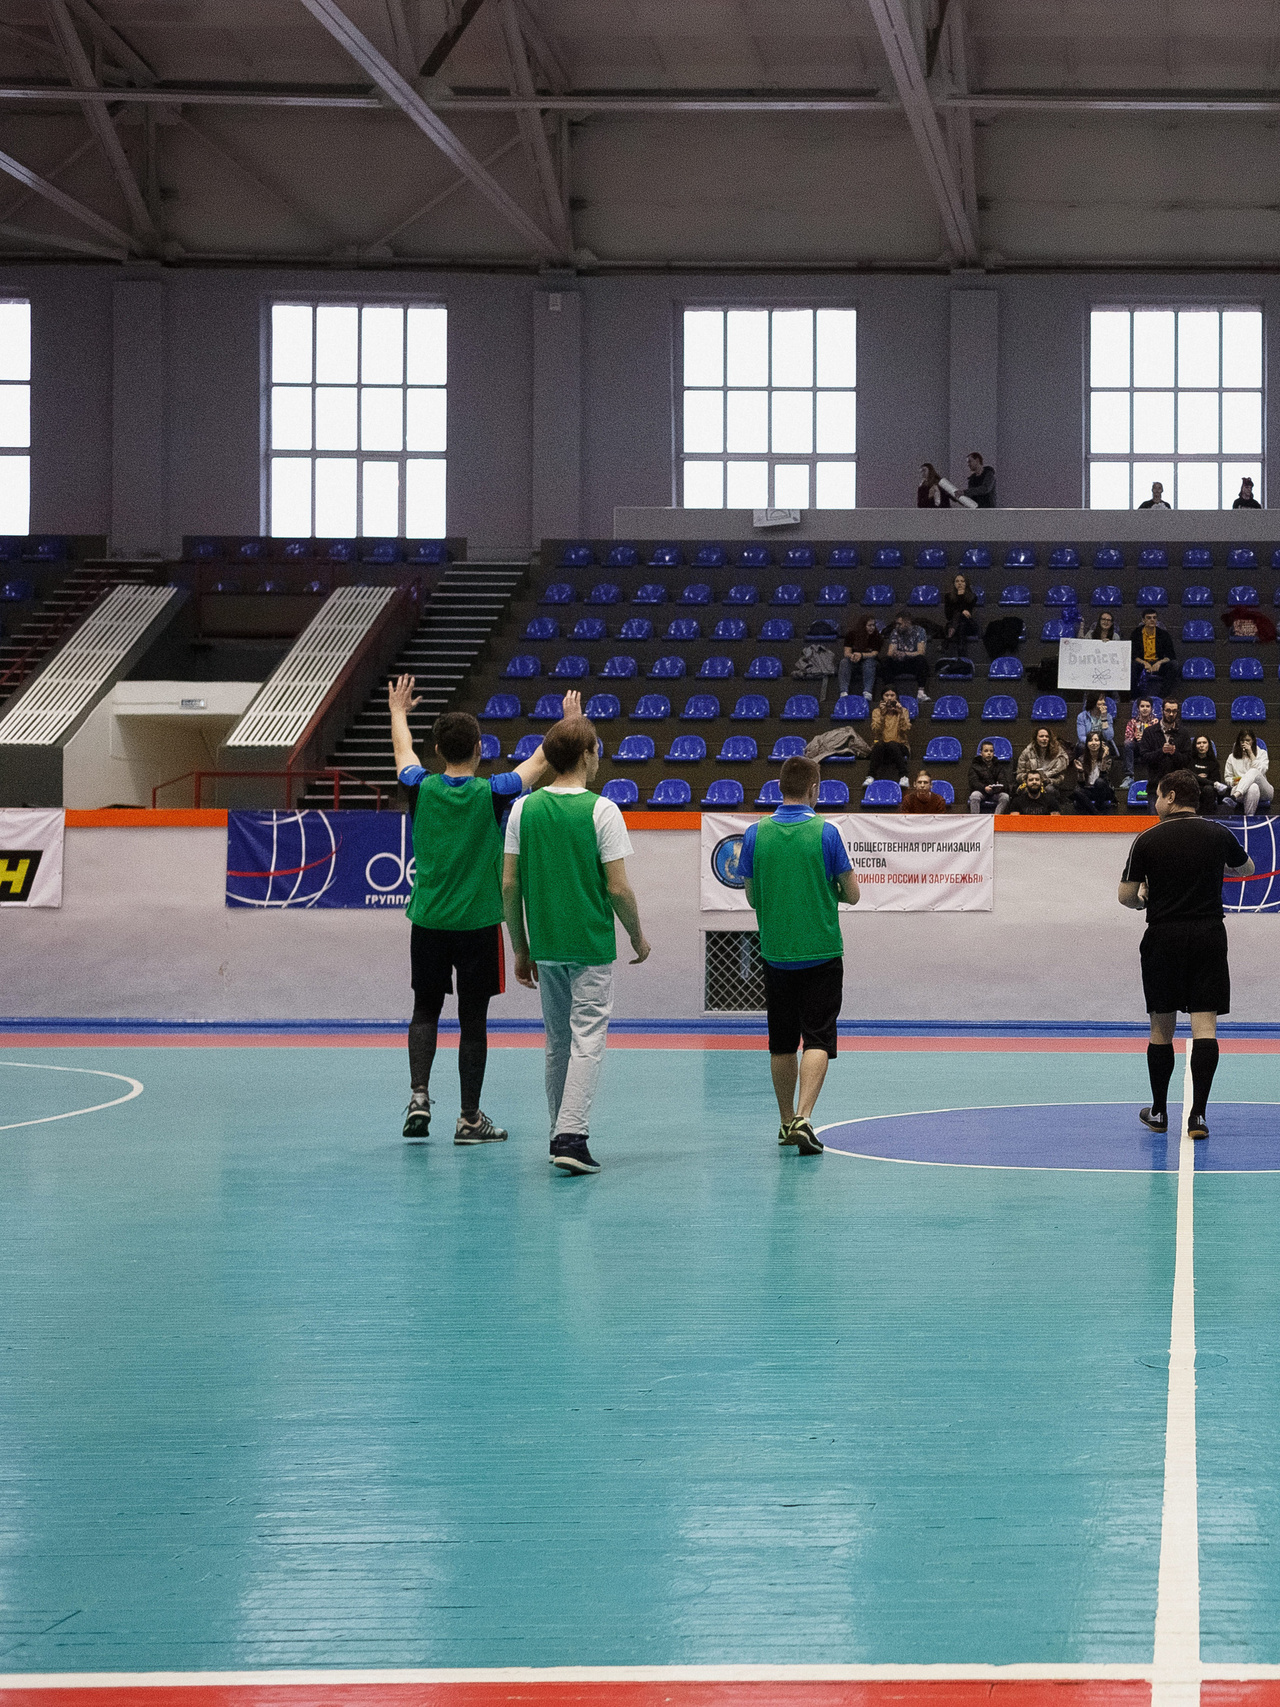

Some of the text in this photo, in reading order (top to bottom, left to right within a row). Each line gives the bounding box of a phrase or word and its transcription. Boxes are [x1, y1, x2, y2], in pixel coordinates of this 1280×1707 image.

[853, 841, 919, 853] ОБЩЕСТВЕННАЯ
[921, 841, 981, 853] ОРГАНИЗАЦИЯ
[887, 873, 919, 884] РОССИИ
[921, 873, 927, 884] И
[928, 873, 983, 884] ЗАРУБЕЖЬЯ»
